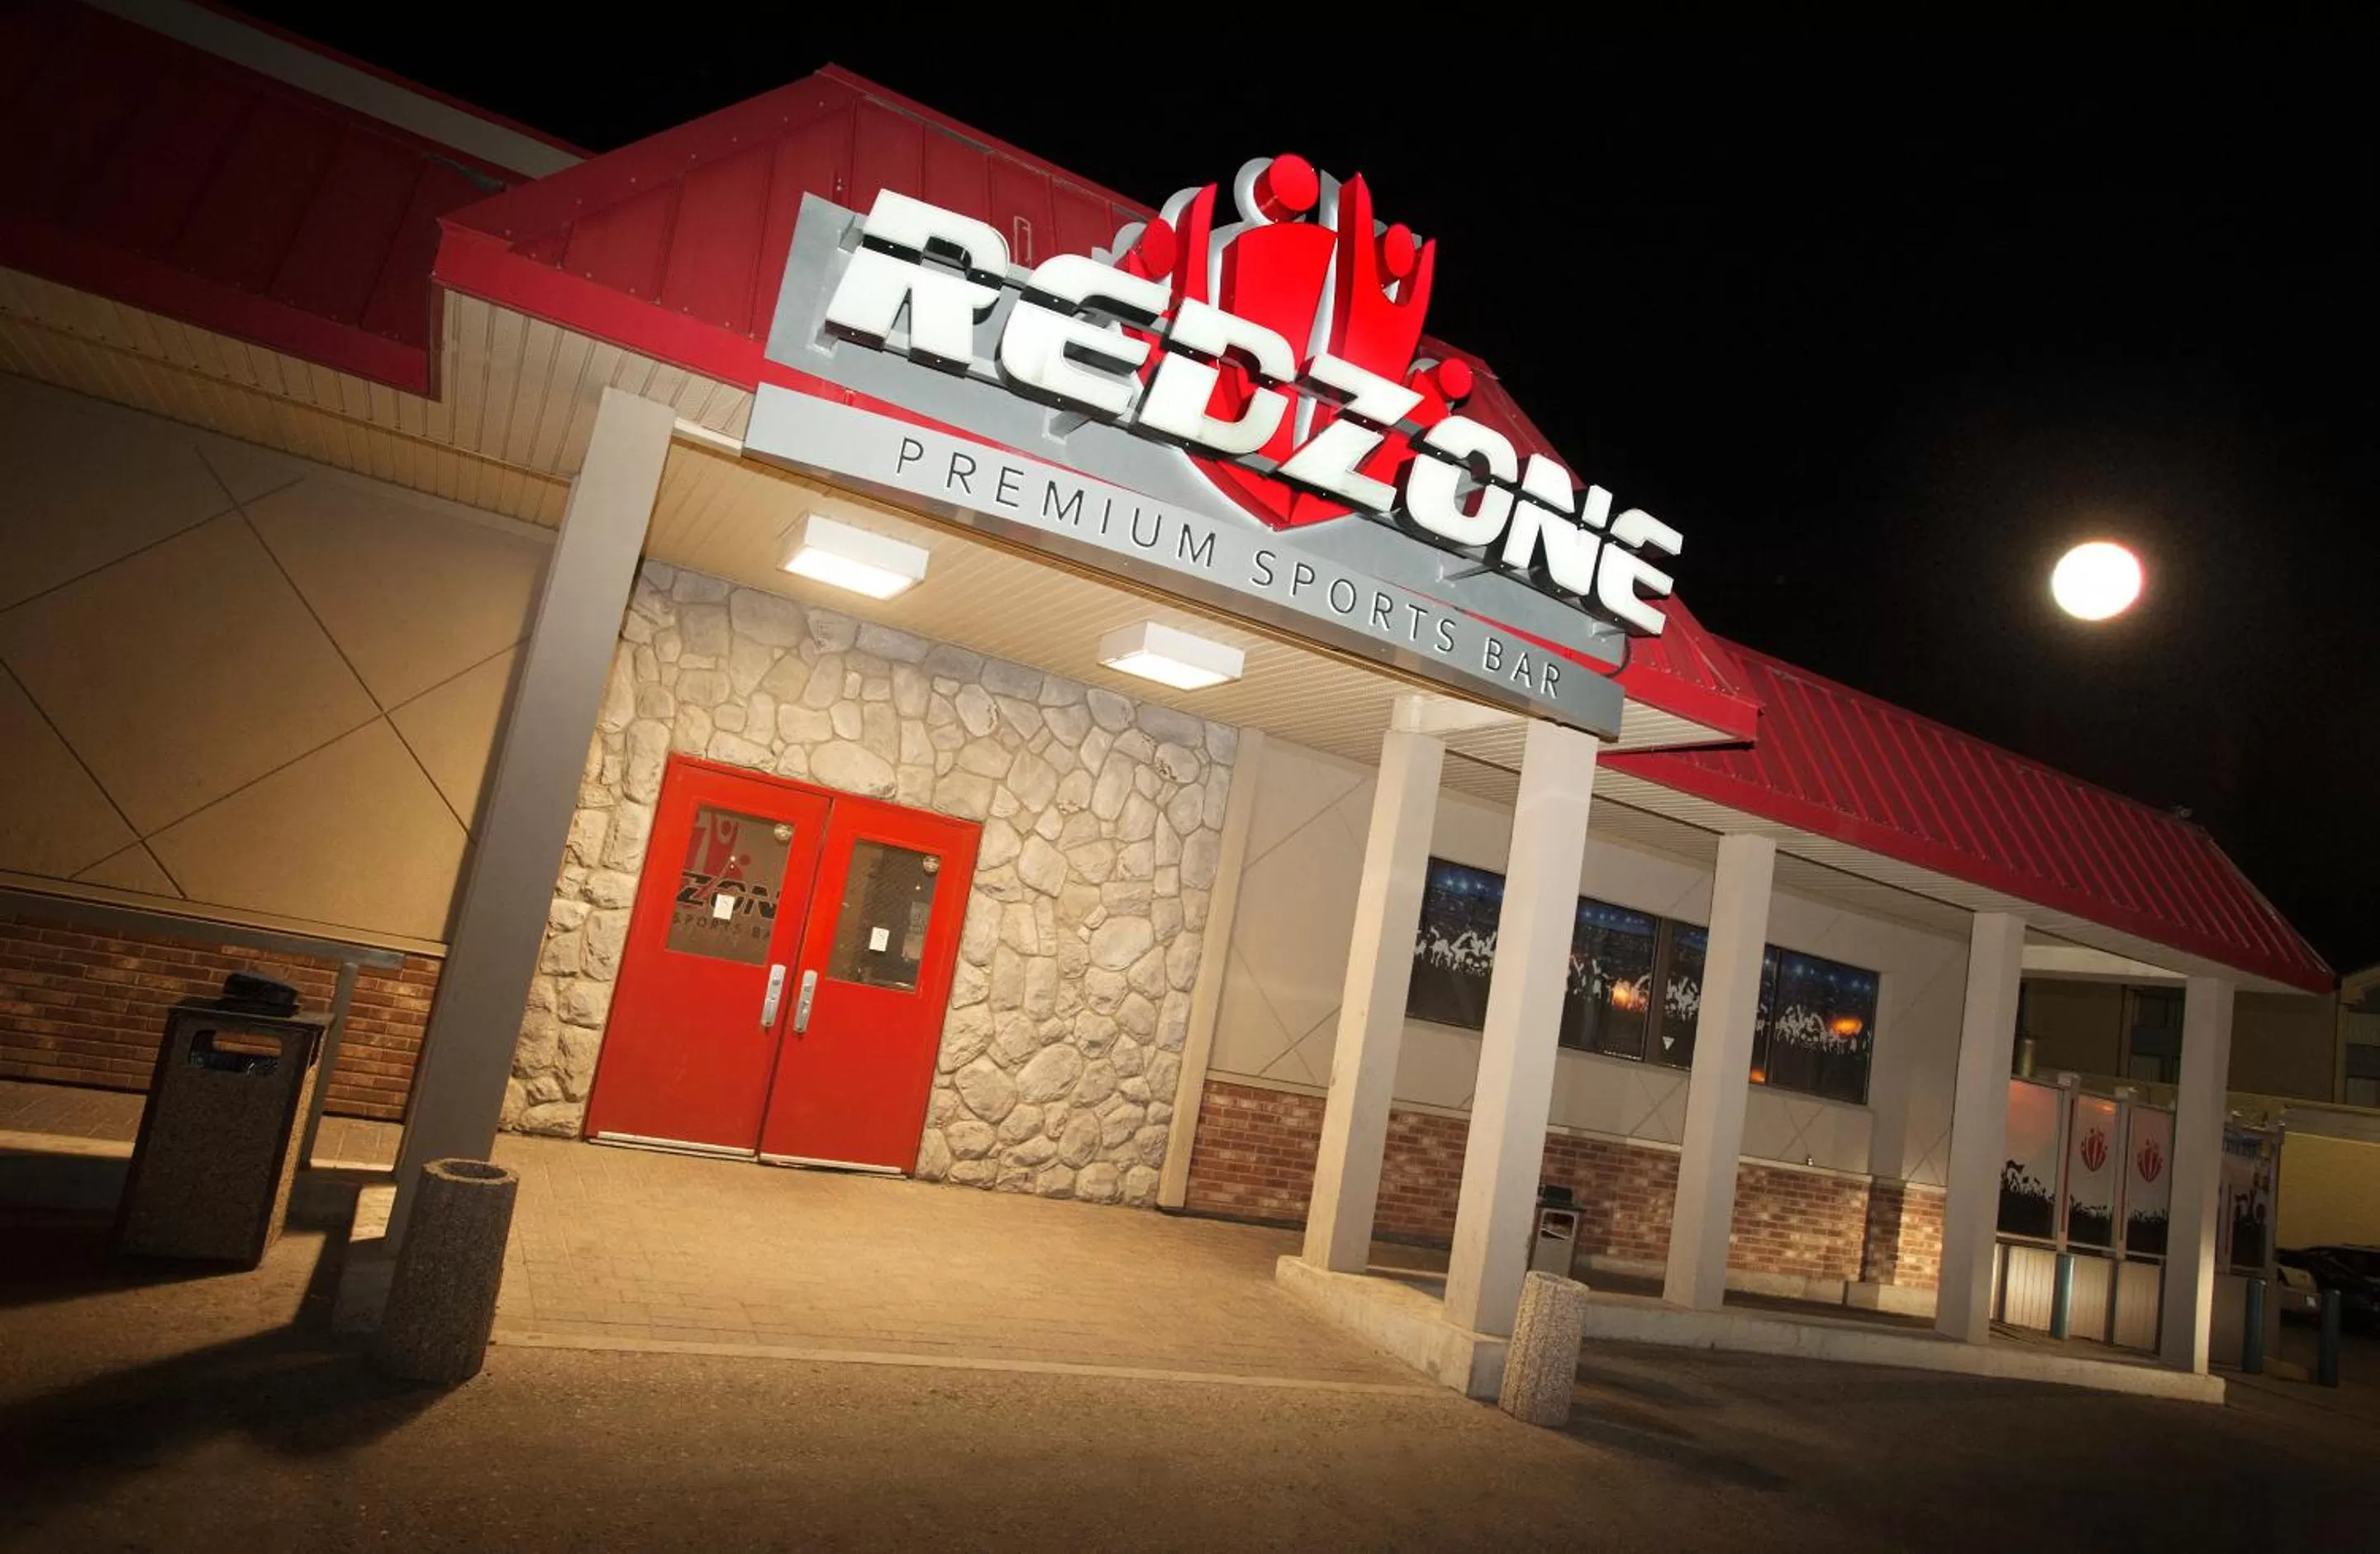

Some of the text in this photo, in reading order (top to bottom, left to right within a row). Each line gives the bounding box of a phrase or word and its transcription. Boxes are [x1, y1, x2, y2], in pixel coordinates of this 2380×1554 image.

[897, 437, 1560, 698] PREMIUM SPORTS BAR
